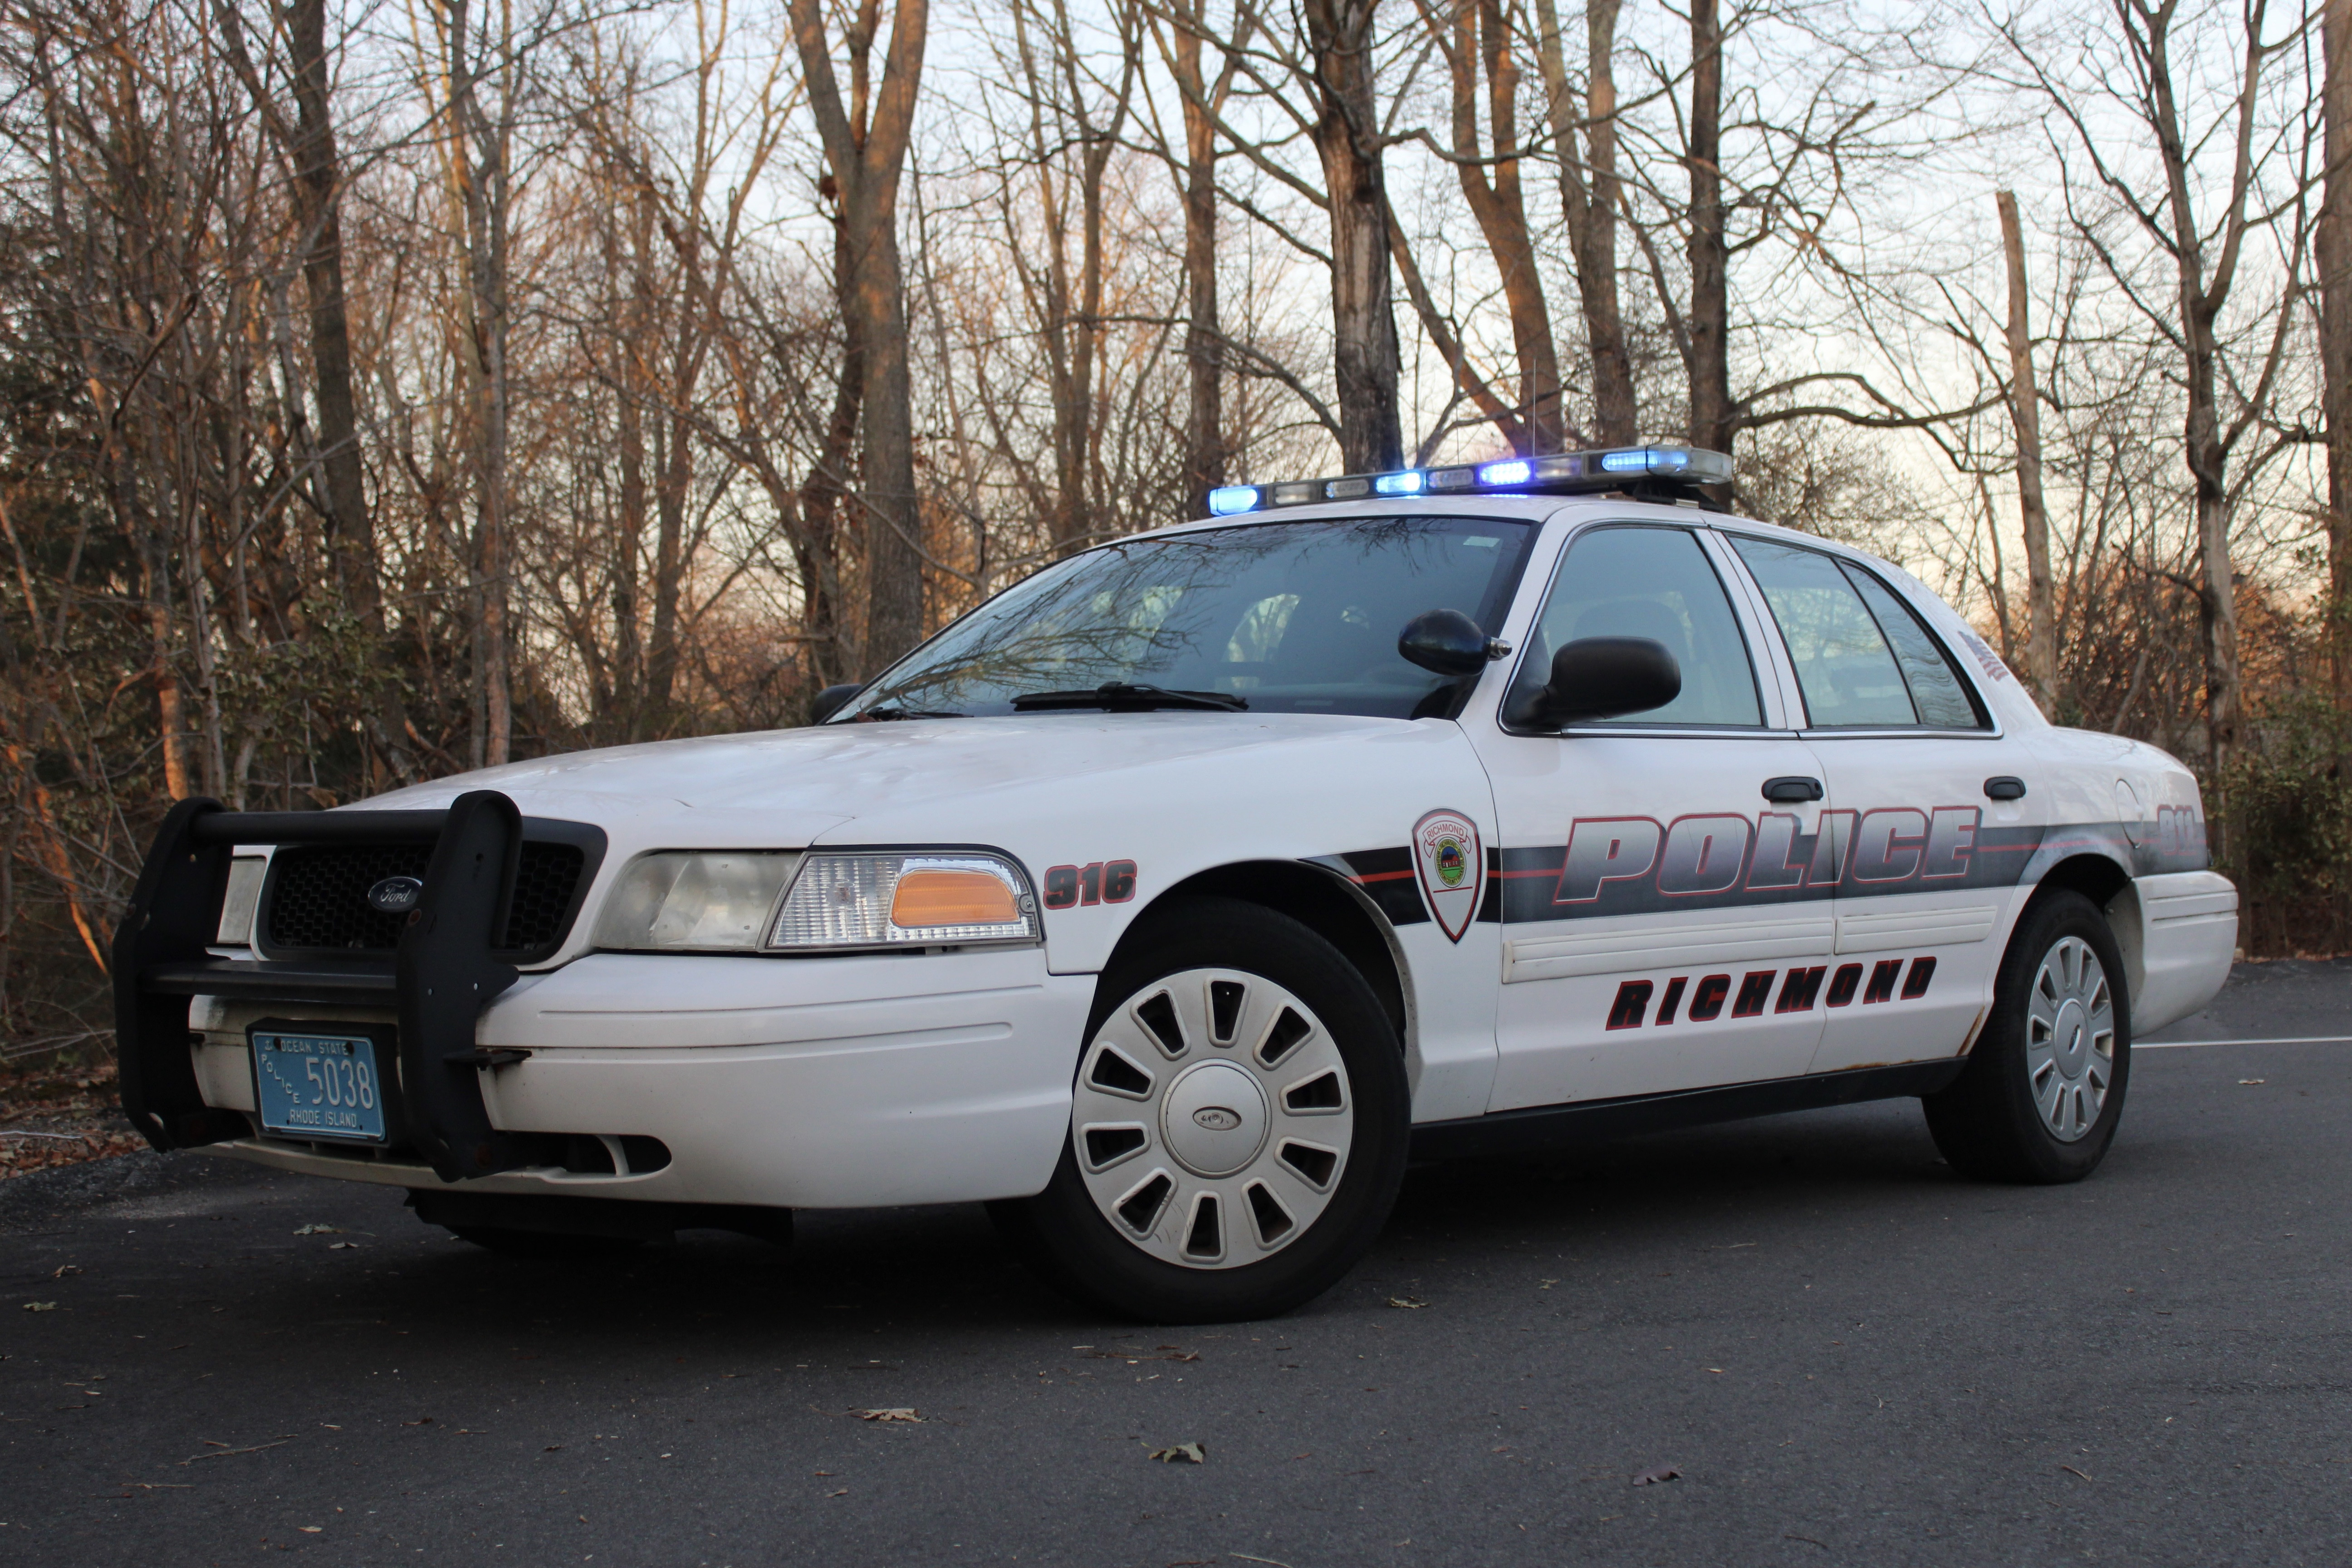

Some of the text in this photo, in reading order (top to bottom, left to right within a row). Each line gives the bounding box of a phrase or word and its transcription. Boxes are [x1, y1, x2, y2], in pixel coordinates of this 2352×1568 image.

[1426, 823, 1464, 840] RICHMOND
[1552, 806, 1983, 905] POLICE
[381, 883, 412, 902] Ford
[1043, 859, 1137, 910] 916
[1605, 956, 1937, 1031] RICHMOND
[280, 1040, 348, 1056] OCEAN STATE
[261, 1054, 301, 1104] POLICE
[306, 1057, 373, 1110] 5038
[289, 1109, 357, 1128] RHODE ISLAND
